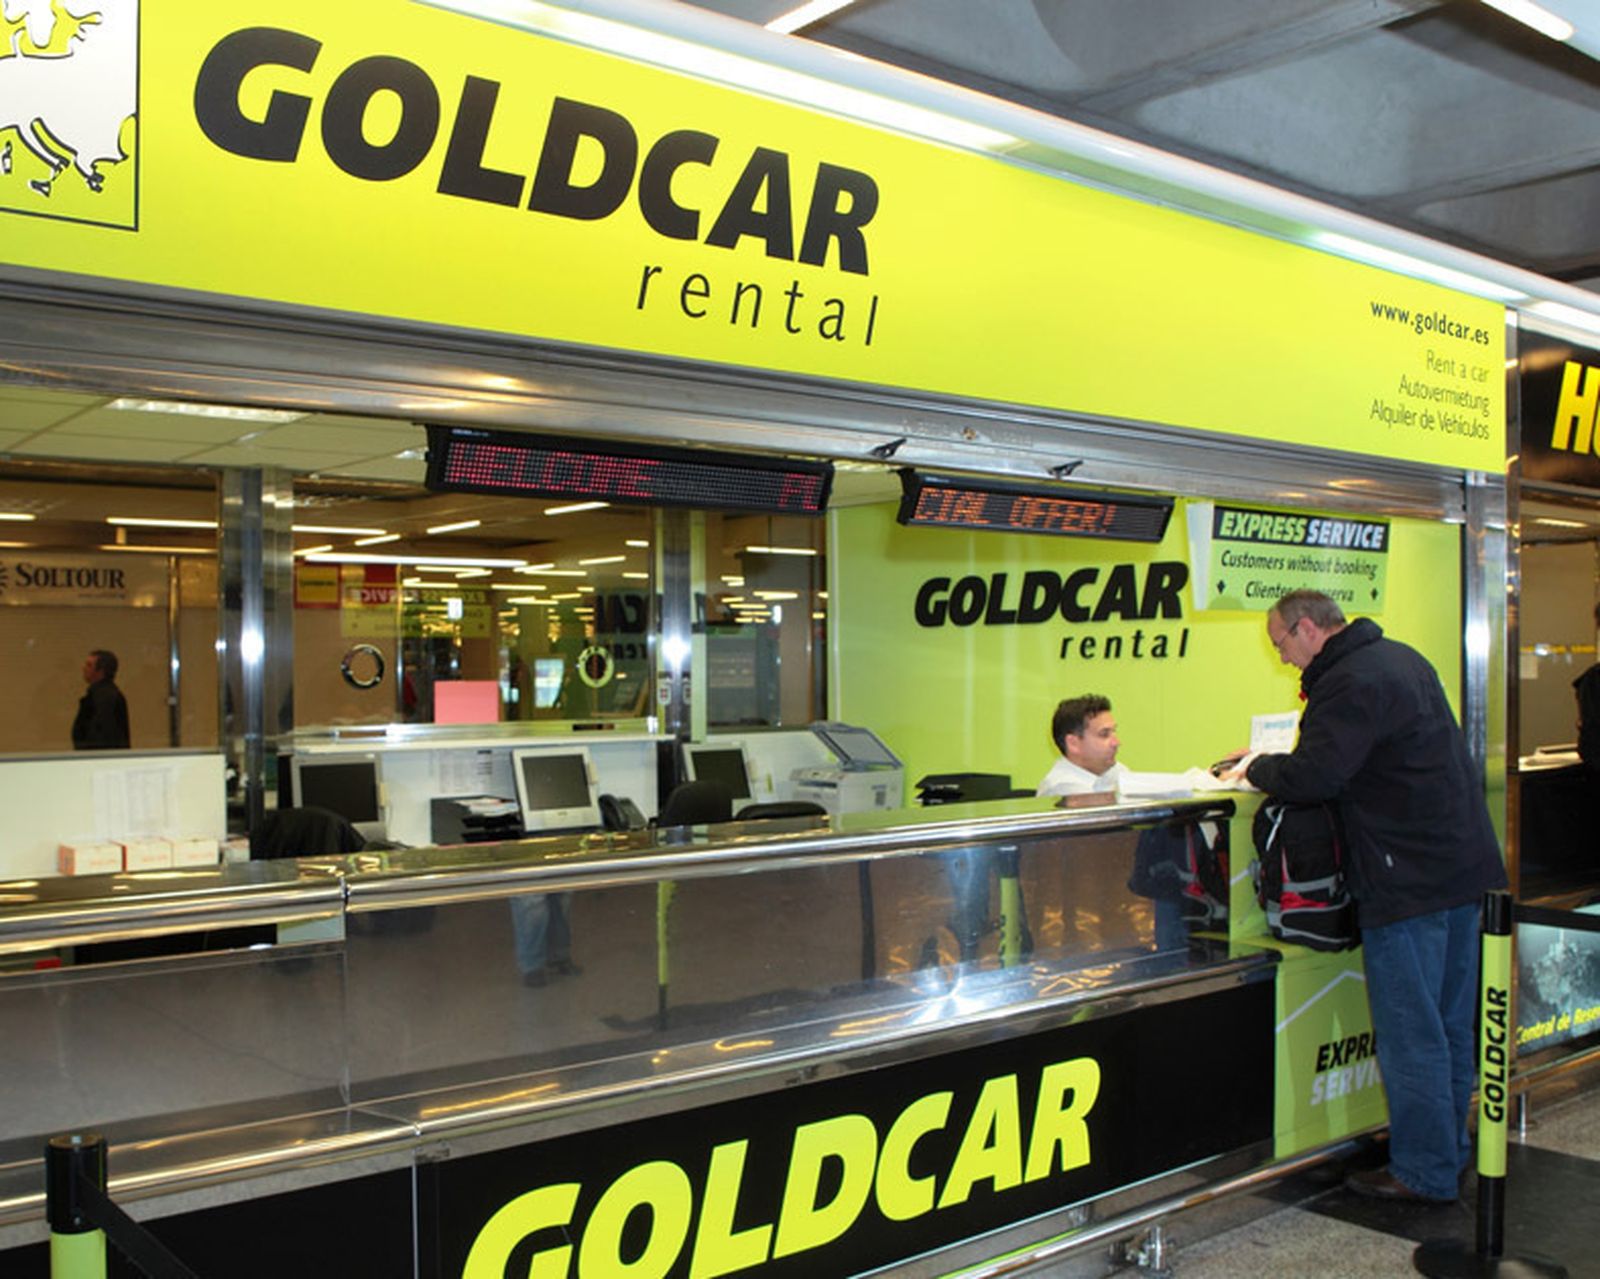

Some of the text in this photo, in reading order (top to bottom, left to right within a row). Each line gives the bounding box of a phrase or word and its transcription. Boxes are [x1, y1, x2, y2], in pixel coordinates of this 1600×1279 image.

[193, 27, 881, 276] GOLDCAR
[637, 262, 878, 347] rental
[1370, 301, 1490, 345] www.goldcar.es
[1426, 349, 1490, 383] Rent a car
[1370, 399, 1417, 428] Alquiler
[1420, 409, 1435, 431] de
[1399, 374, 1490, 417] Autovermietung
[1551, 360, 1600, 458] H
[446, 441, 661, 498] WELCOME
[914, 486, 1118, 534] CIAL OFFER!
[1219, 511, 1385, 549] EXPRESS SERVICE
[1221, 549, 1379, 581] Customers without booking
[914, 561, 1189, 628] GOLDCAR
[1060, 628, 1189, 660] rental
[1557, 1011, 1570, 1032] de
[1484, 986, 1507, 1124] GOLDCAR
[463, 1056, 1101, 1279] GOLDCAR
